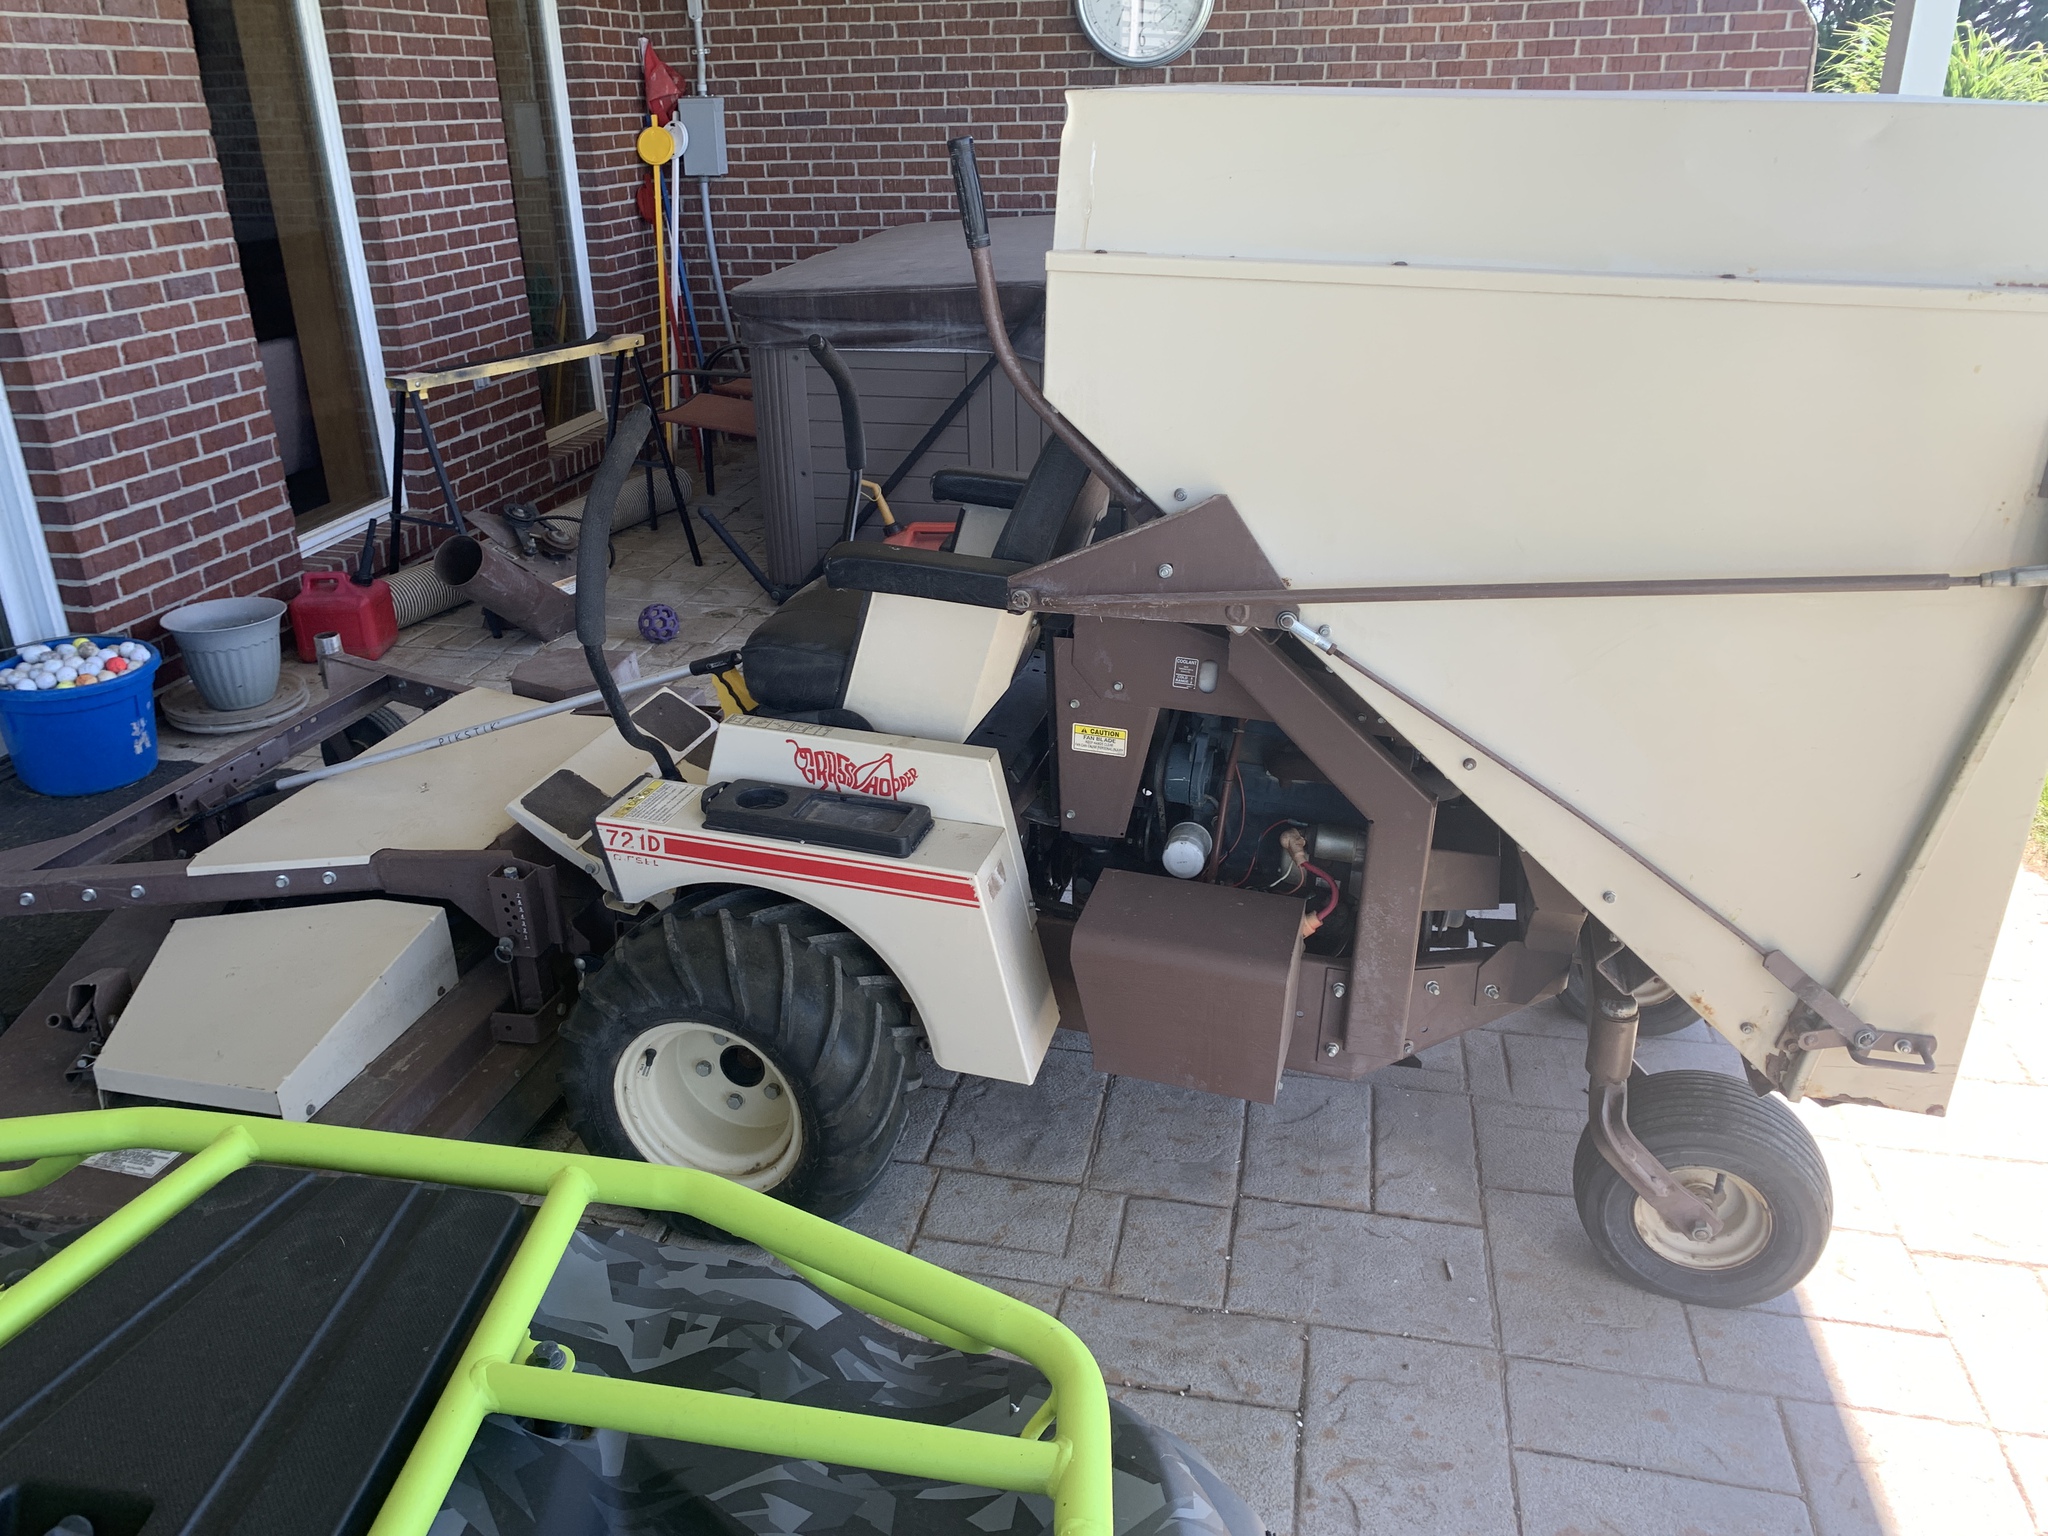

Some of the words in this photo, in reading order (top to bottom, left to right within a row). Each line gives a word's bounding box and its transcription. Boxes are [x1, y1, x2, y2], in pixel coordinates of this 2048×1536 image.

[438, 722, 499, 746] PIKSTIK
[1090, 728, 1120, 738] CAUTION
[1095, 736, 1116, 744] BLADE
[606, 829, 660, 852] 721D
